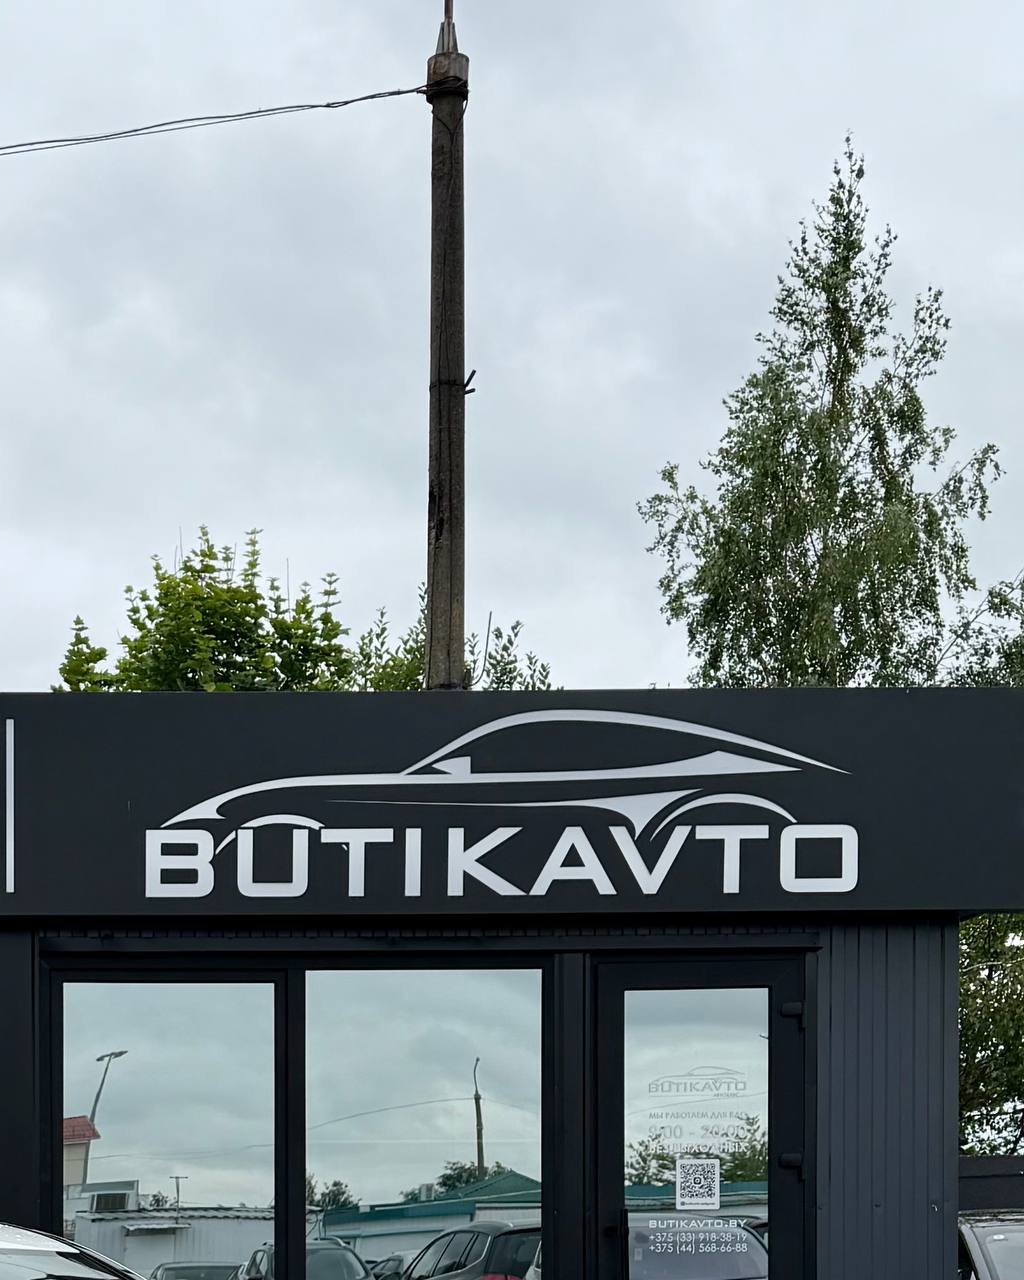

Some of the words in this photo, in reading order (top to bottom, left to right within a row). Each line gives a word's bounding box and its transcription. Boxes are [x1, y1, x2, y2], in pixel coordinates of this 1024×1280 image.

[144, 822, 860, 899] BUTIKAVTO
[648, 1080, 748, 1094] BUTIKAVTO
[648, 1219, 747, 1229] BUTIKAVTO.BY
[648, 1232, 673, 1242] +375
[676, 1232, 696, 1244] (33)
[698, 1232, 747, 1242] 918-38-19
[648, 1243, 673, 1253] +375
[676, 1243, 696, 1255] (44)
[698, 1243, 748, 1253] 568-66-88
